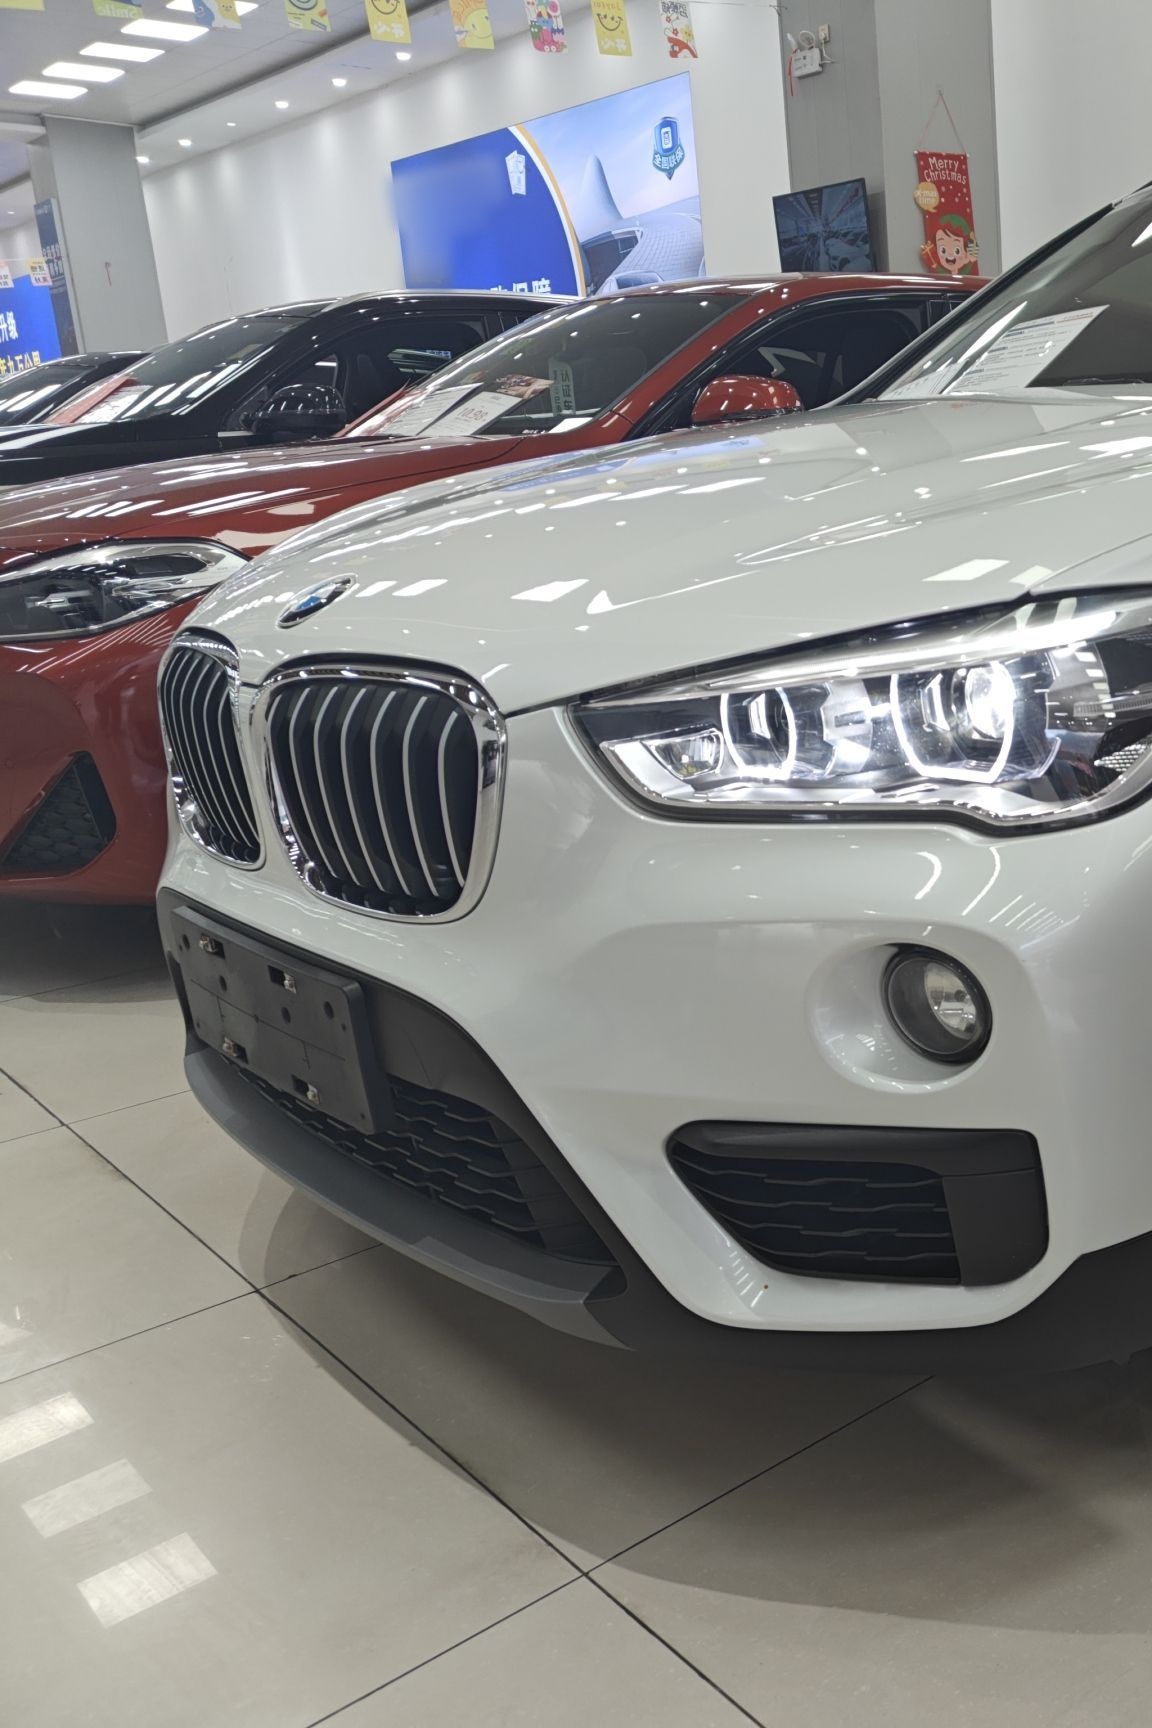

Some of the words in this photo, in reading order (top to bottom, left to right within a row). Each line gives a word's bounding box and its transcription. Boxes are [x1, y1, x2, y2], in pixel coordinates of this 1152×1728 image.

[652, 145, 684, 170] 全国联保
[928, 156, 959, 171] Merry
[923, 169, 967, 185] Christmas
